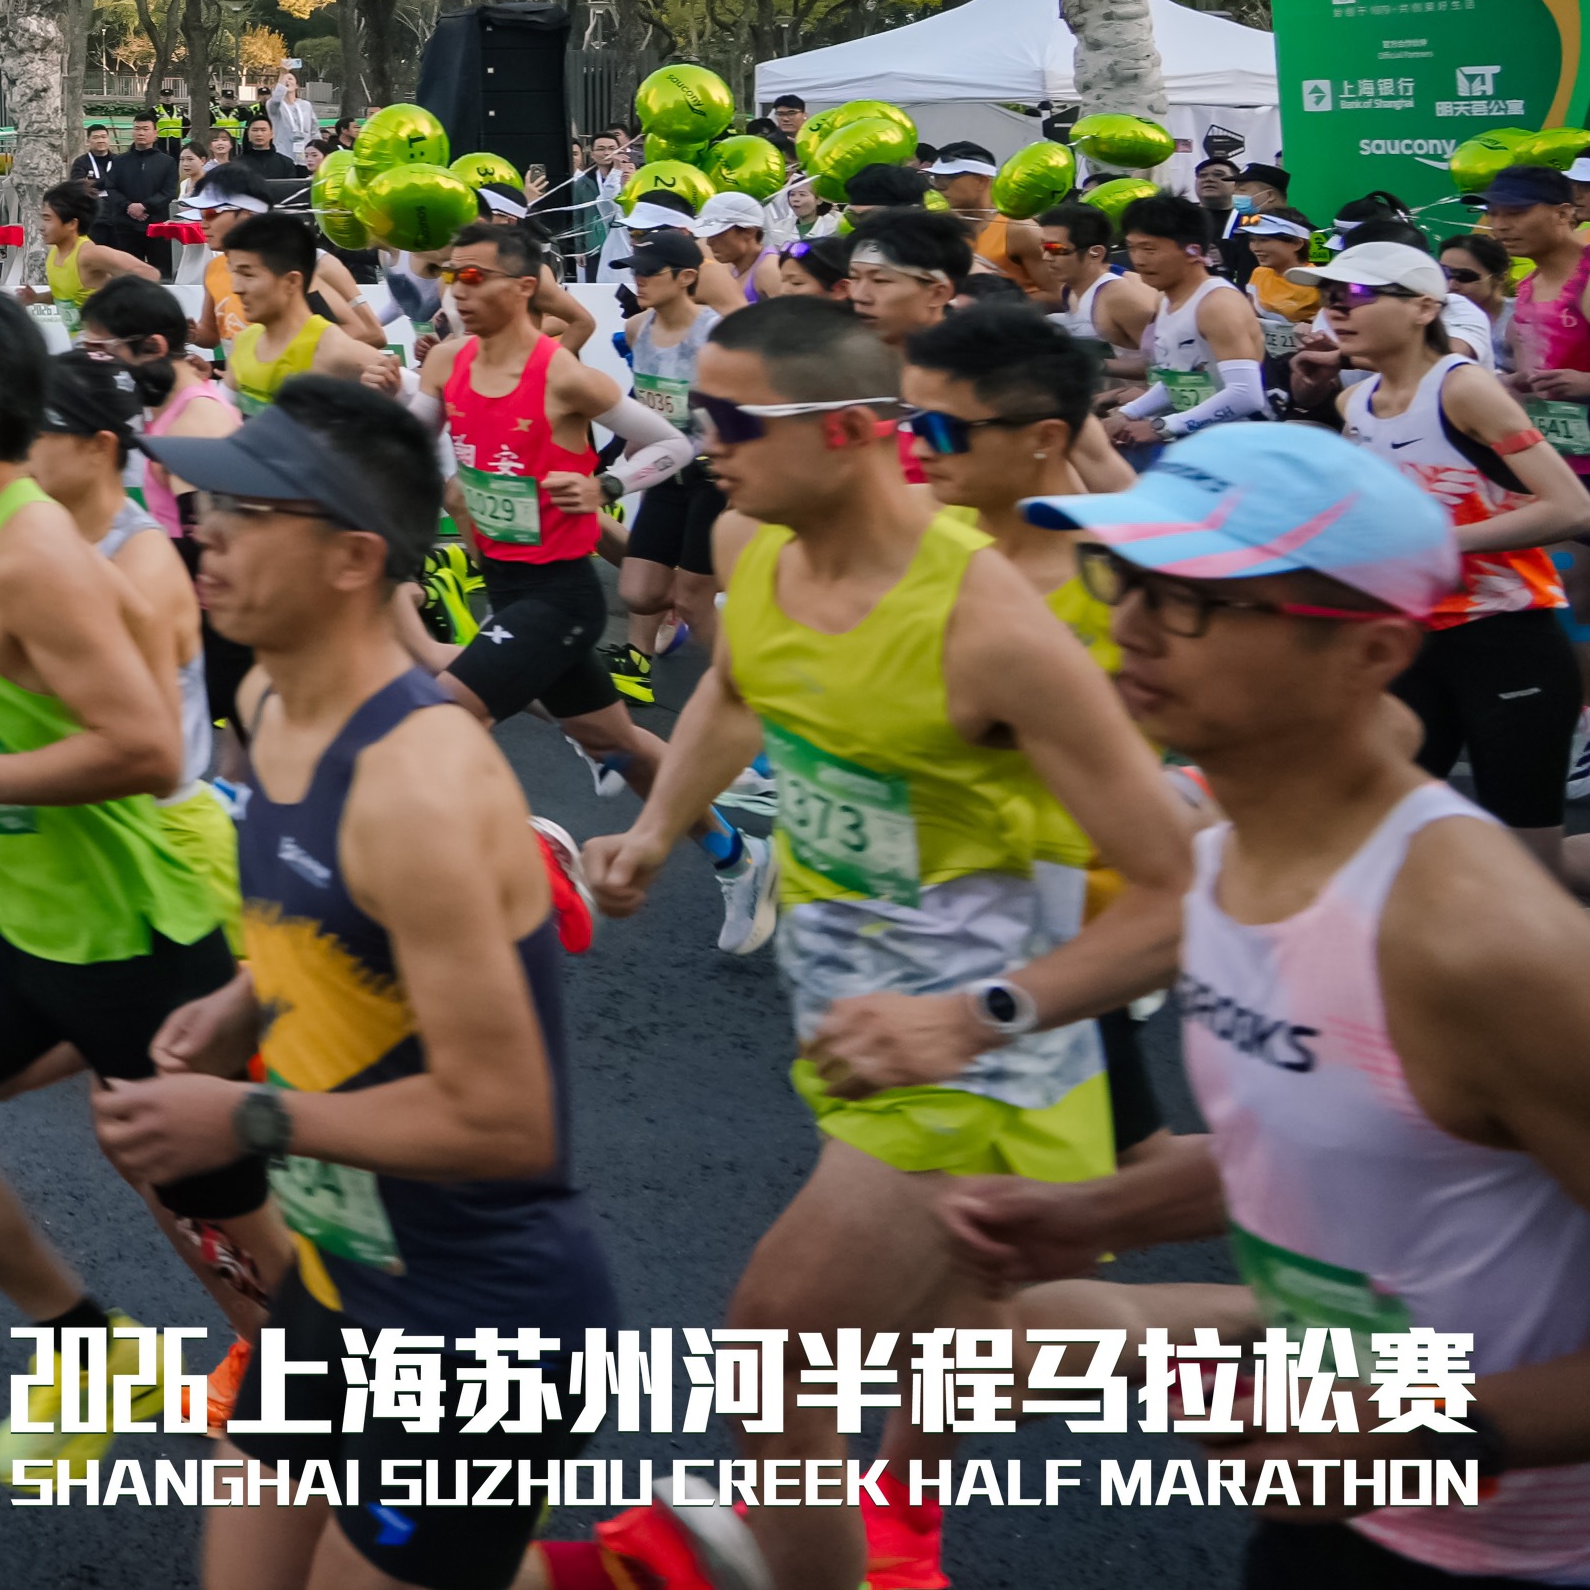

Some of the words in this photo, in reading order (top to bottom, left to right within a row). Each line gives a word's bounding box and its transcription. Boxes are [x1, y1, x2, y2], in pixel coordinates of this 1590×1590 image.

[1339, 78, 1415, 98] 上海银行
[1359, 139, 1456, 160] saucony
